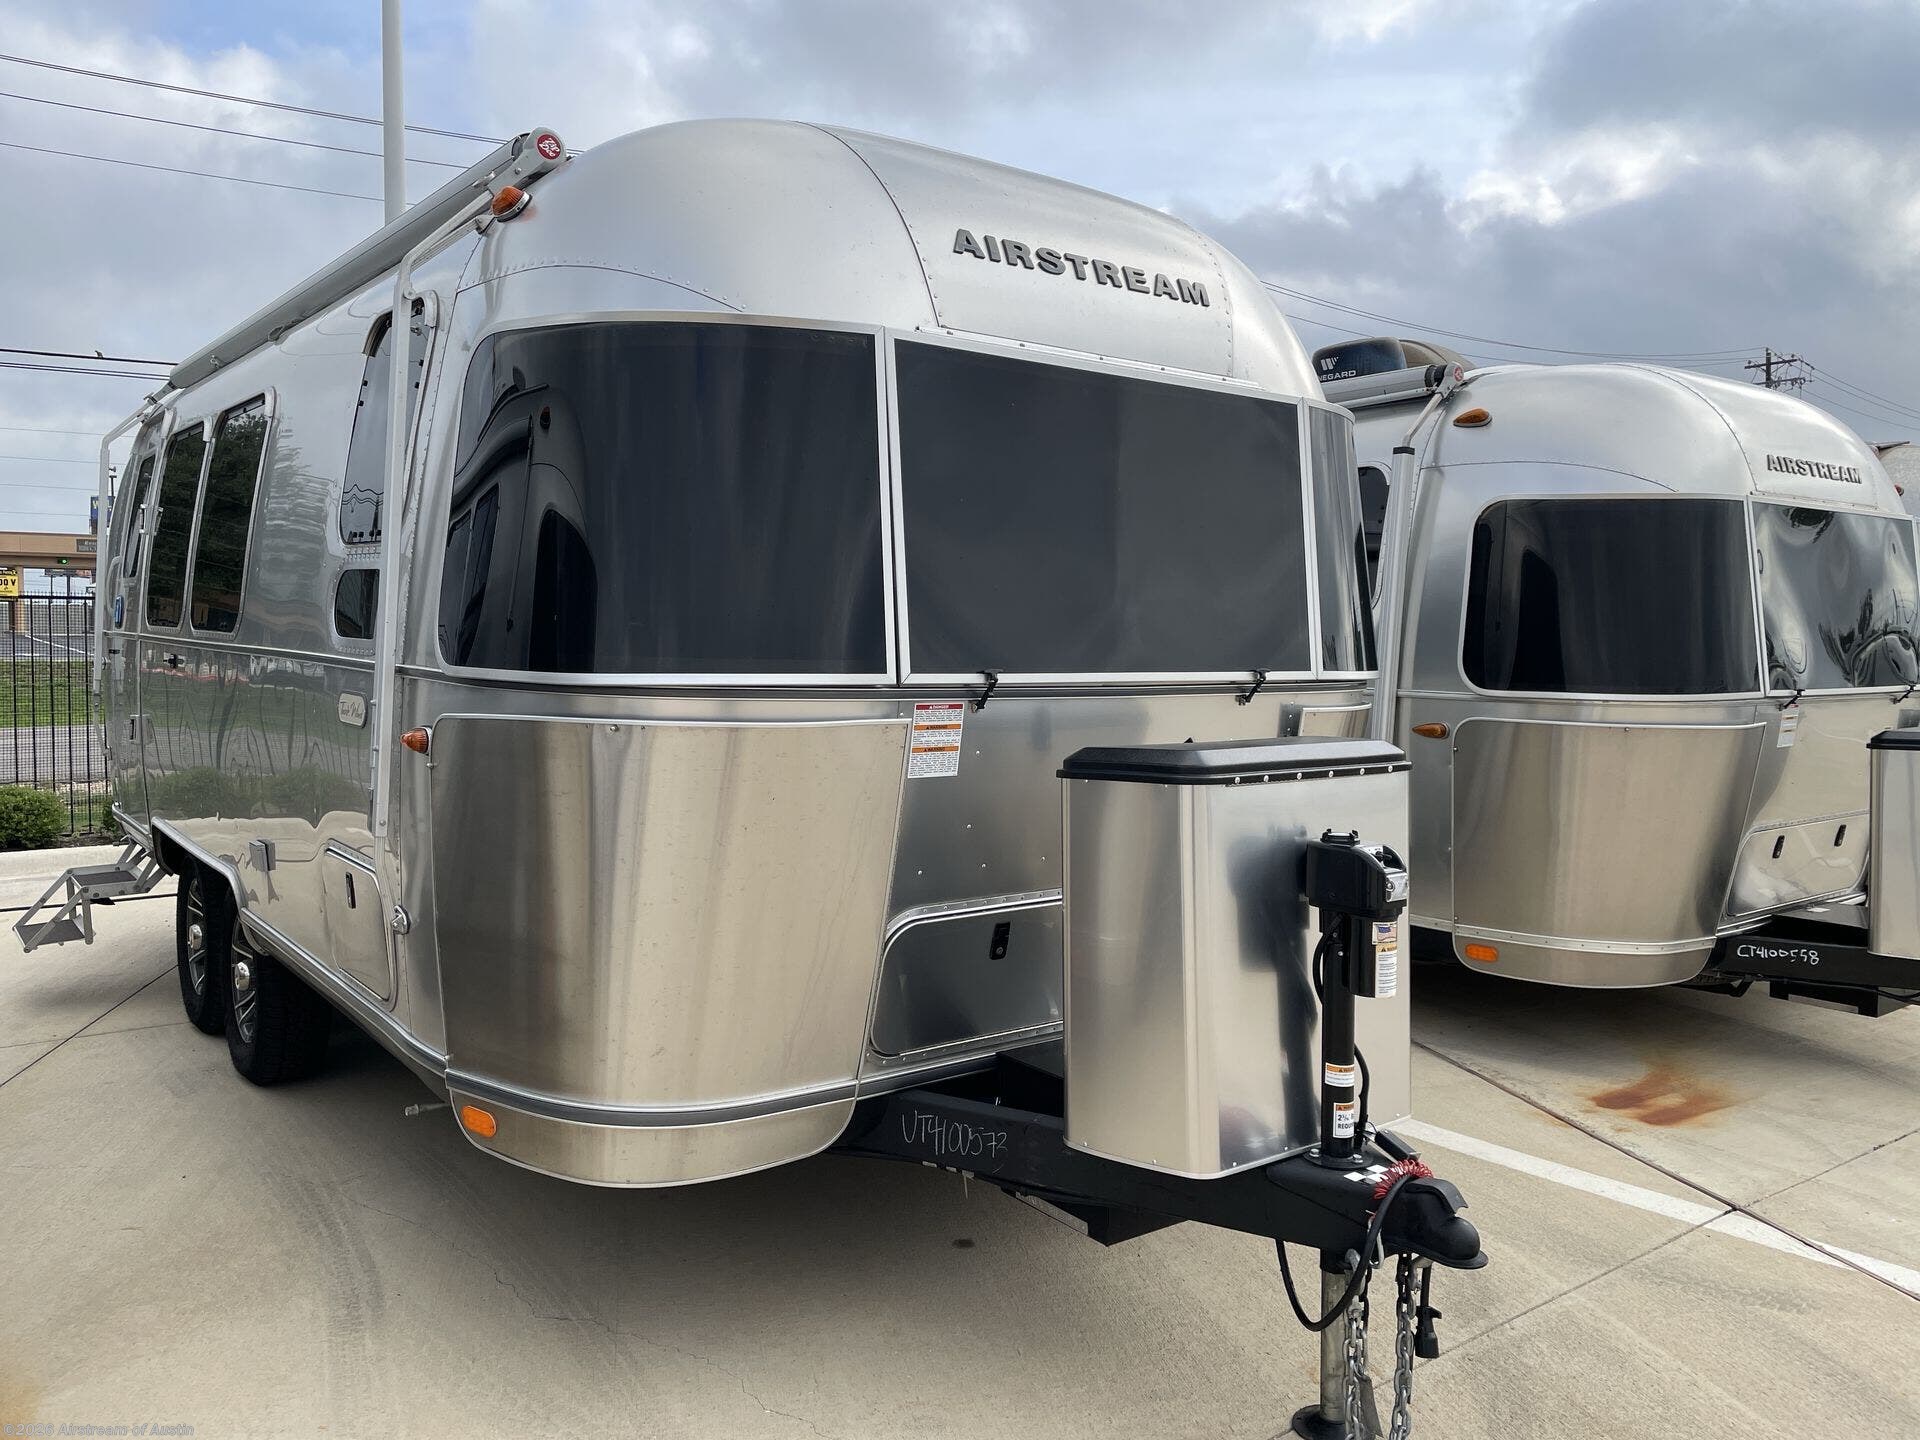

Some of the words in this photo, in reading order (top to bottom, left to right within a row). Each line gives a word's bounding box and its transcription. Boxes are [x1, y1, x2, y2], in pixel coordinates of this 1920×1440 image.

[953, 228, 1210, 307] AIRSTREAM
[1766, 454, 1862, 485] AIRSTREAM
[1737, 944, 1819, 966] CT4100558
